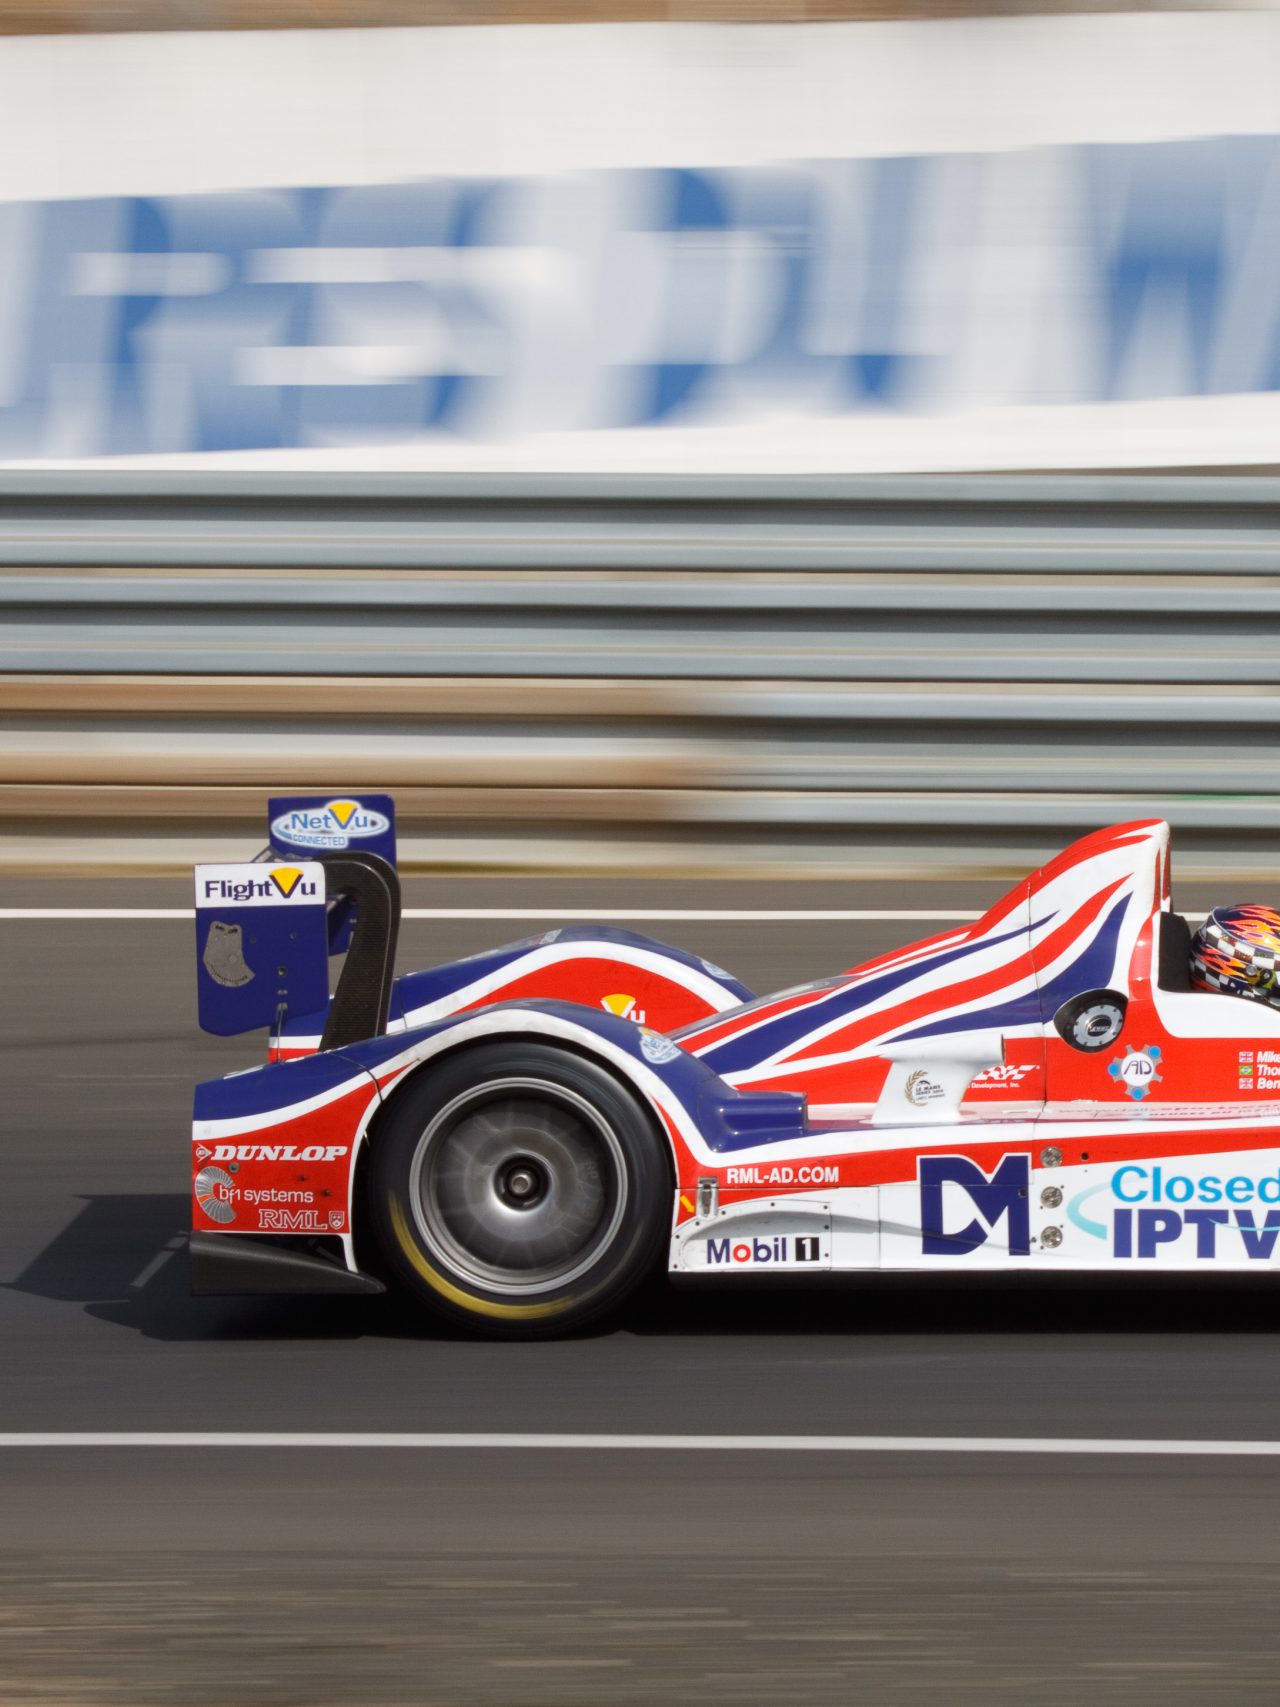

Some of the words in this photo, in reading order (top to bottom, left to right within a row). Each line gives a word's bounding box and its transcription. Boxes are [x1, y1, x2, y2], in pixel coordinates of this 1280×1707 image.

[290, 801, 369, 831] NetVu
[292, 834, 347, 847] CONNECTED
[204, 867, 317, 901] FlightVu
[210, 1144, 348, 1162] DUNLOP
[726, 1166, 840, 1185] RML-AD.COM
[258, 1208, 328, 1230] RML
[706, 1236, 787, 1265] Mobil
